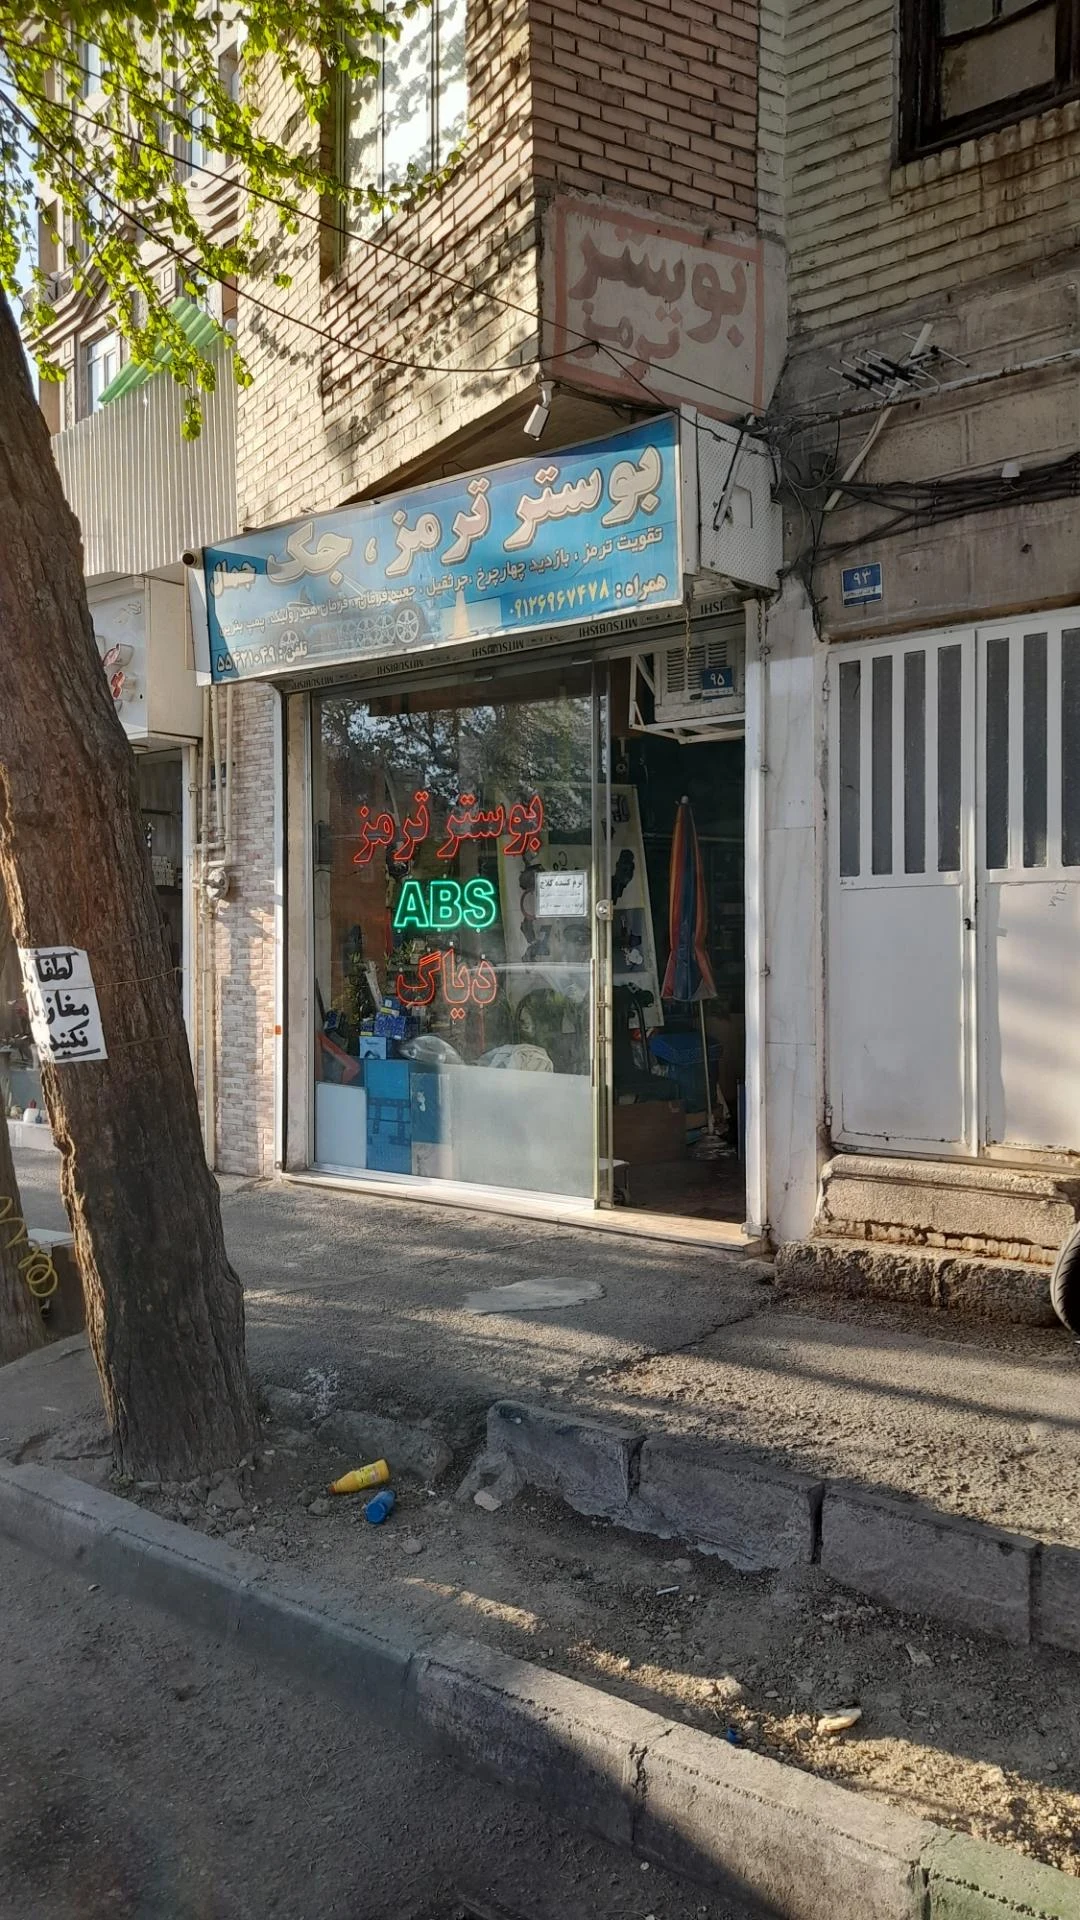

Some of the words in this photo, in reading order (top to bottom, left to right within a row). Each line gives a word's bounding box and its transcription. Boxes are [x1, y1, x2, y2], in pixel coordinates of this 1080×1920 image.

[568, 225, 748, 348] بوستر
[503, 445, 663, 552] بوستر
[385, 477, 491, 577] ترمز
[617, 526, 664, 552] تقویت
[266, 520, 353, 586] جک
[530, 548, 570, 572] بازدید
[583, 539, 613, 564] ترمز
[210, 559, 257, 596] جمال
[853, 567, 872, 586] ۹۳
[579, 616, 638, 638] MITSUBISHI
[710, 672, 725, 687] ۹۵
[352, 790, 430, 863] ترمز
[436, 793, 543, 858] بوستر
[393, 878, 496, 929] ABS
[395, 948, 498, 1020] دیاگ
[49, 1018, 90, 1056] نکنید
